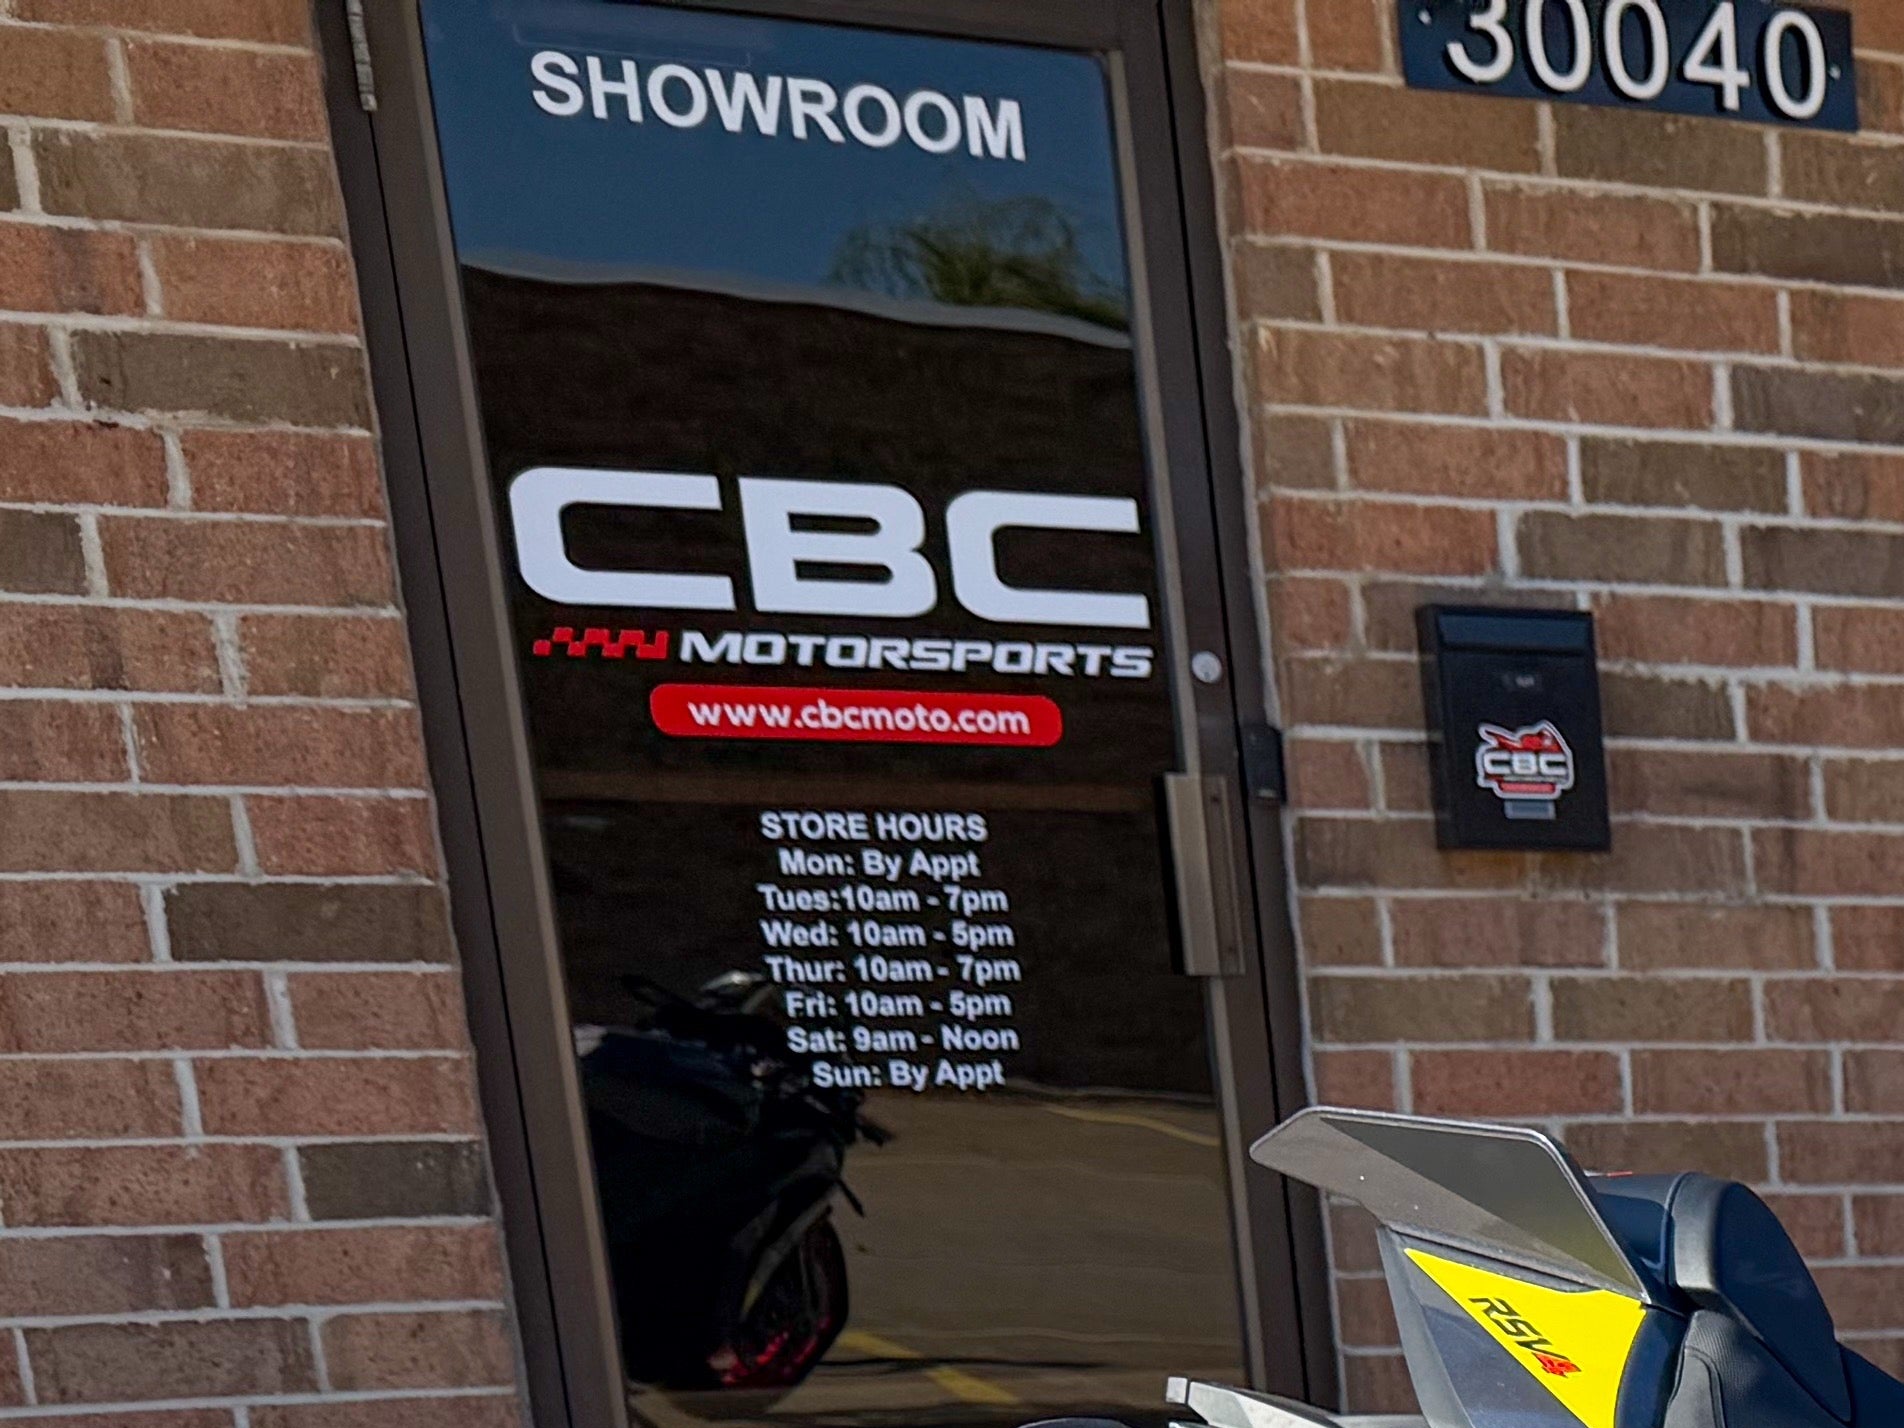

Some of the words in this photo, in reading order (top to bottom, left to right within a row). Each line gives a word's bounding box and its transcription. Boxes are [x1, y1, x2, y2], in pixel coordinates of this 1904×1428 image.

[1446, 0, 1826, 119] 30040
[530, 50, 1026, 161] SHOWROOM
[510, 466, 1151, 629] CBC
[680, 629, 1153, 677] MOTORSPORTS
[688, 698, 1030, 735] www.cbcmoto.com
[1483, 750, 1568, 775] CBC
[760, 810, 871, 840] STORE
[875, 812, 988, 841] HOURS
[778, 847, 855, 877] Mon:
[862, 849, 901, 882] By
[909, 849, 982, 882] Appt
[943, 884, 1009, 917] 7pm
[759, 919, 839, 947] Wed:
[847, 920, 927, 947] 10am
[950, 921, 1016, 952] 5pm
[762, 954, 847, 983] Thur:
[853, 954, 934, 983] 10am
[956, 955, 1022, 987] 7pm
[785, 991, 838, 1018] Fri:
[845, 991, 924, 1018] 10am
[949, 991, 1013, 1022] 5pm
[786, 1025, 847, 1053] Sat:
[852, 1026, 919, 1052] 9am
[940, 1024, 1021, 1051] Noon
[812, 1061, 883, 1088] Sun:
[888, 1060, 929, 1092] By
[934, 1059, 1006, 1091] Appt
[1468, 1297, 1582, 1379] RSV4
